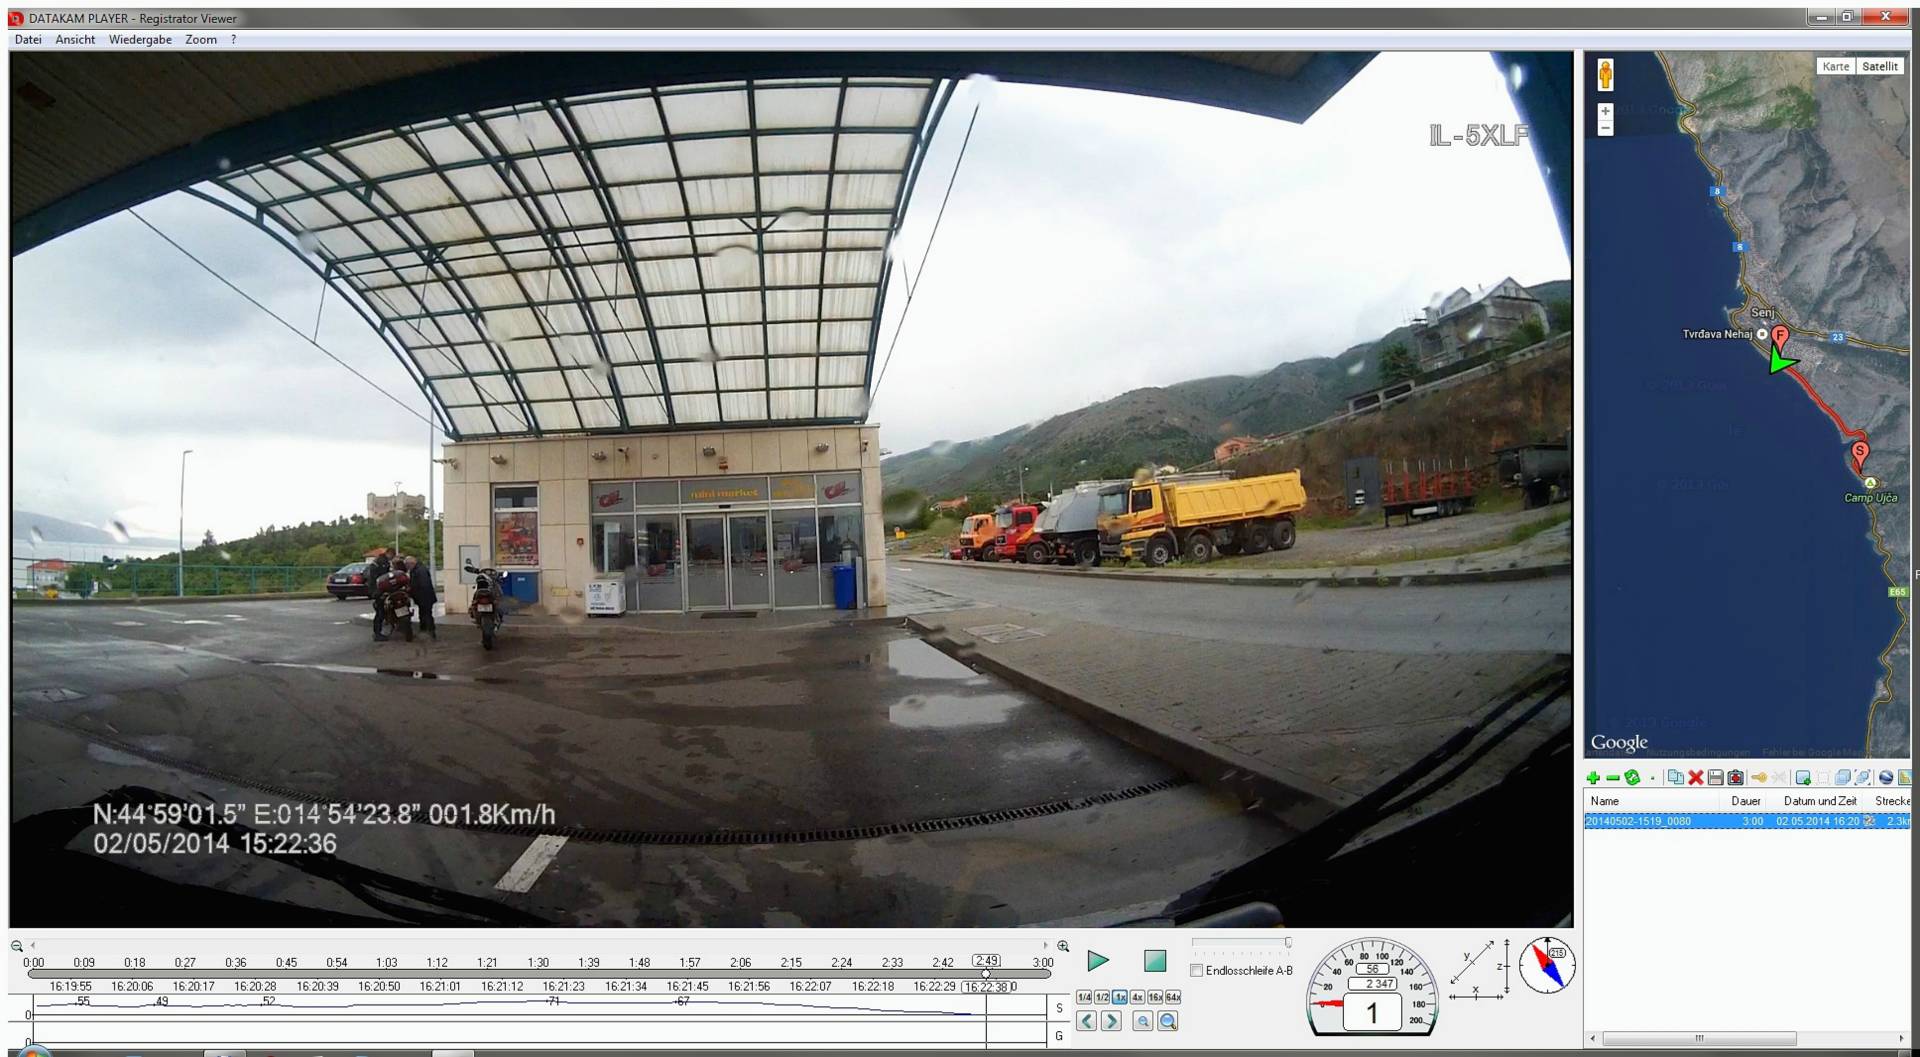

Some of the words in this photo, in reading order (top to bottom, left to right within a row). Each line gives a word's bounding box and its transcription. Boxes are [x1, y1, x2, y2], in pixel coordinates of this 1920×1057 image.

[29, 13, 85, 24] DATAKAM
[88, 13, 129, 24] PLAYER
[139, 13, 198, 27] Registrator
[201, 13, 238, 24] Viewer
[15, 34, 42, 45] Datei
[55, 34, 96, 45] Ansicht
[109, 34, 173, 48] Wiedergabe
[185, 34, 218, 45] Zoom
[231, 34, 237, 45] ?
[1823, 61, 1850, 71] Karte
[1862, 60, 1899, 71] Satellit
[1751, 307, 1775, 320] Senj
[1683, 329, 1722, 339] Tvrđava
[1725, 329, 1753, 341] Nehaj
[1776, 330, 1784, 340] F
[1832, 332, 1843, 341] 23
[1856, 445, 1864, 456] S
[1844, 492, 1874, 505] Camp
[1876, 491, 1898, 505] Ujča
[1890, 587, 1906, 596] E65
[1591, 734, 1649, 754] Google
[1591, 796, 1620, 806] Name
[1731, 796, 1761, 806] Dauer
[1784, 796, 1815, 806] Datum
[1818, 796, 1837, 806] und
[1838, 796, 1857, 806] Zeit
[1875, 796, 1910, 806] Strecke
[1586, 816, 1692, 828] 20140502-1519_0080
[1742, 816, 1764, 826] 3:00
[1776, 816, 1830, 826] 02.05.2014
[1833, 816, 1860, 826] 16:20
[1550, 949, 1564, 957] 215
[23, 957, 45, 967] 0:00
[73, 957, 95, 967] 0:09
[124, 957, 146, 967] 0:18
[174, 957, 197, 967] 0:27
[225, 957, 247, 967] 0:36
[275, 957, 298, 967] 0:45
[326, 957, 348, 967] 0:54
[376, 957, 398, 967] 1:03
[426, 957, 448, 967] 1:12
[477, 957, 497, 967] 1:21
[527, 957, 550, 967] 1:30
[578, 957, 600, 967] 1:39
[629, 957, 651, 967] 1:48
[679, 957, 701, 967] 1:57
[730, 957, 752, 967] 2:06
[780, 957, 803, 967] 2:15
[831, 957, 853, 967] 2:24
[881, 957, 904, 967] 2:33
[932, 957, 954, 967] 2:42
[976, 955, 998, 966] 2:49
[1032, 957, 1054, 967] 3:00
[1206, 965, 1274, 976] Endlosschleife
[1276, 965, 1293, 976] A-B
[1366, 964, 1379, 974] 56
[50, 981, 92, 991] 16:19:55
[112, 981, 154, 991] 16:20:06
[174, 981, 216, 991] 16:20:17
[235, 981, 277, 991] 16:20:28
[298, 981, 339, 991] 16:20:39
[359, 981, 401, 991] 16:20:50
[420, 981, 461, 991] 16:21:01
[482, 981, 524, 991] 16:21:12
[544, 981, 585, 991] 16:21:23
[606, 981, 648, 991] 16:21:34
[667, 981, 709, 991] 16:21:45
[729, 981, 771, 991] 16:21:56
[790, 981, 832, 991] 16:22:07
[853, 981, 895, 991] 16:22:18
[914, 981, 956, 991] 16:22:29
[965, 982, 1008, 992] 16:22:38
[1323, 983, 1333, 991] 20
[1376, 979, 1394, 988] 347
[1409, 983, 1423, 991] 160
[1079, 993, 1092, 1001] 1/4
[1097, 993, 1110, 1001] 1/2
[1116, 993, 1126, 1001] 1x
[1132, 993, 1143, 1001] 4x
[1149, 993, 1163, 1001] 16x
[1166, 993, 1181, 1001] 64x
[1056, 1003, 1063, 1013] S
[1367, 1002, 1377, 1024] 1
[25, 1010, 31, 1020] 0
[1055, 1030, 1063, 1041] G
